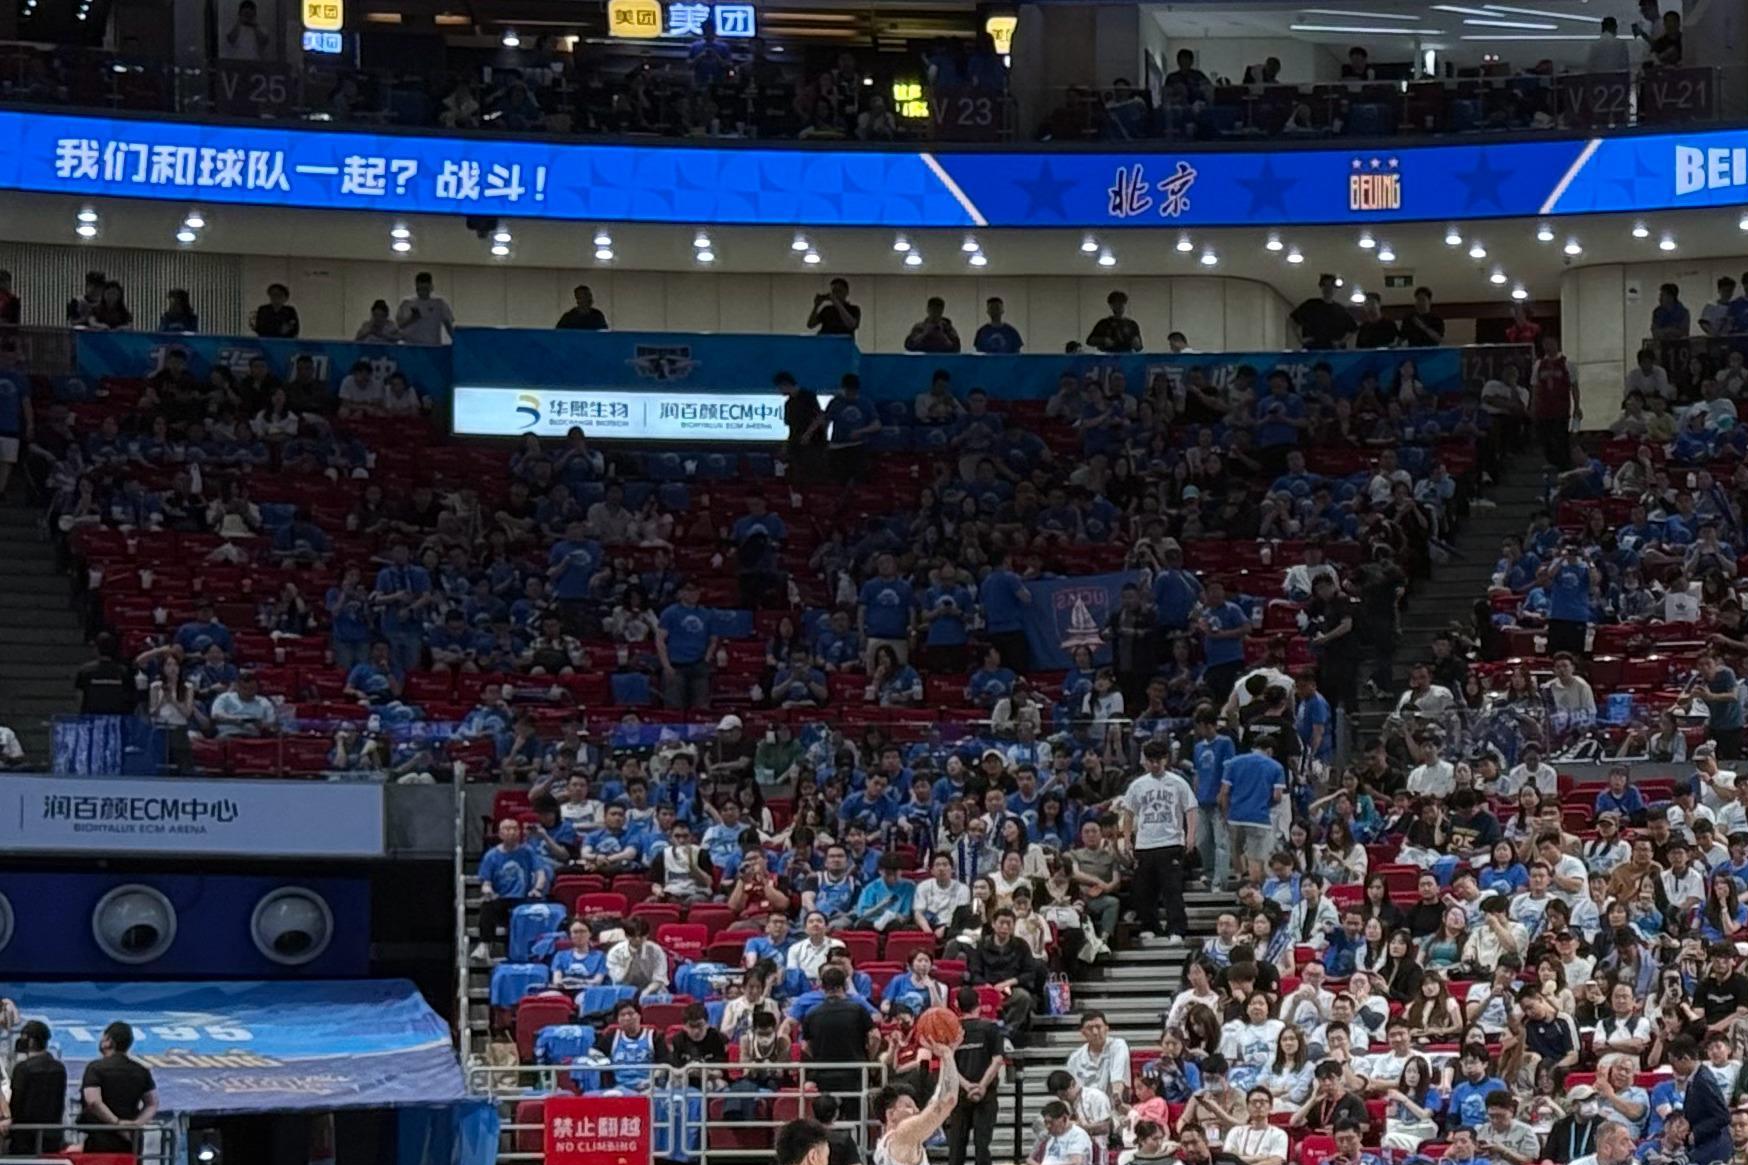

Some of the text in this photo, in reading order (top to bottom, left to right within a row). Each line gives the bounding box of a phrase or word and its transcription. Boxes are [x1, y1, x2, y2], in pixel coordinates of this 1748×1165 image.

[308, 4, 339, 20] 美团
[616, 9, 657, 26] 美团
[667, 3, 757, 36] 美团
[221, 70, 287, 104] V 25
[1592, 84, 1626, 113] 22
[1677, 80, 1707, 109] 21
[957, 97, 993, 126] 23
[1107, 161, 1199, 219] 北京
[1349, 173, 1401, 211] BEIJING
[549, 399, 629, 419] 华熙生物
[43, 794, 239, 823] 润百颜ECM中心
[139, 824, 165, 834] ECM
[552, 1116, 642, 1138] 禁止翻越
[555, 1141, 638, 1153] NO CLIMBING
